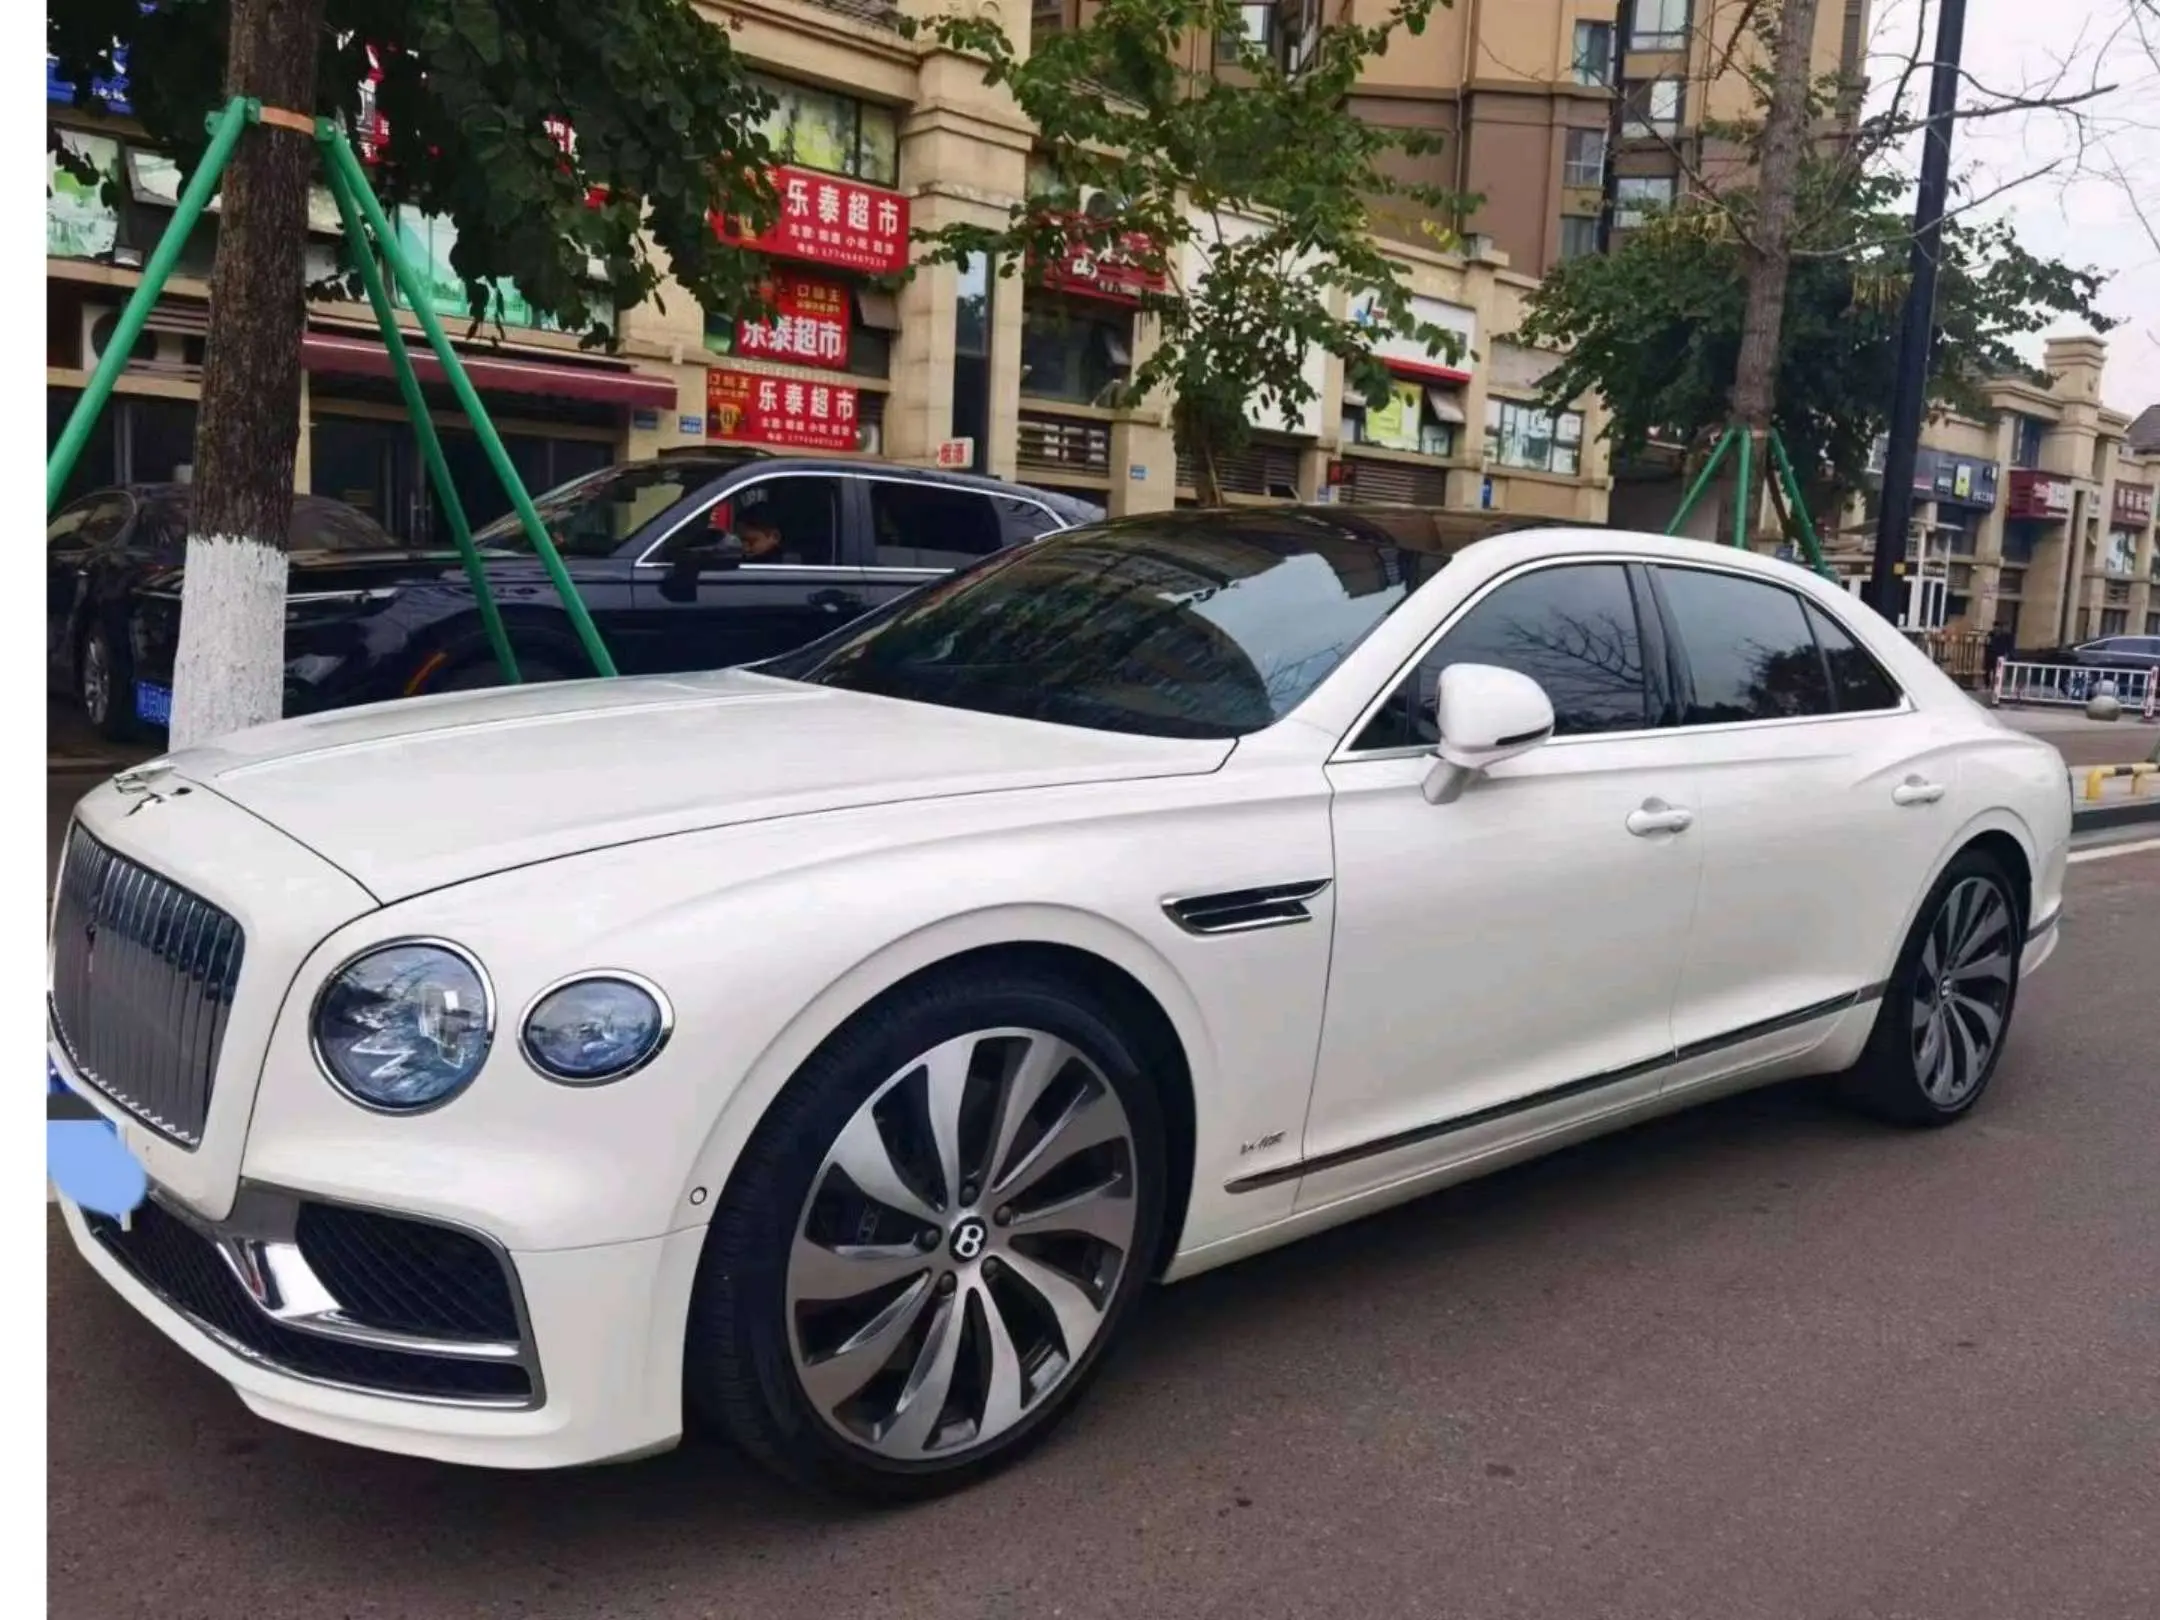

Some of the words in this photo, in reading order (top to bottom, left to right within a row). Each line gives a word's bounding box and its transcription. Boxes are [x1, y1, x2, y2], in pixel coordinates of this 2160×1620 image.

[787, 178, 899, 236] 乐泰超市
[758, 380, 854, 421] 乐泰超市
[955, 1224, 984, 1258] B
